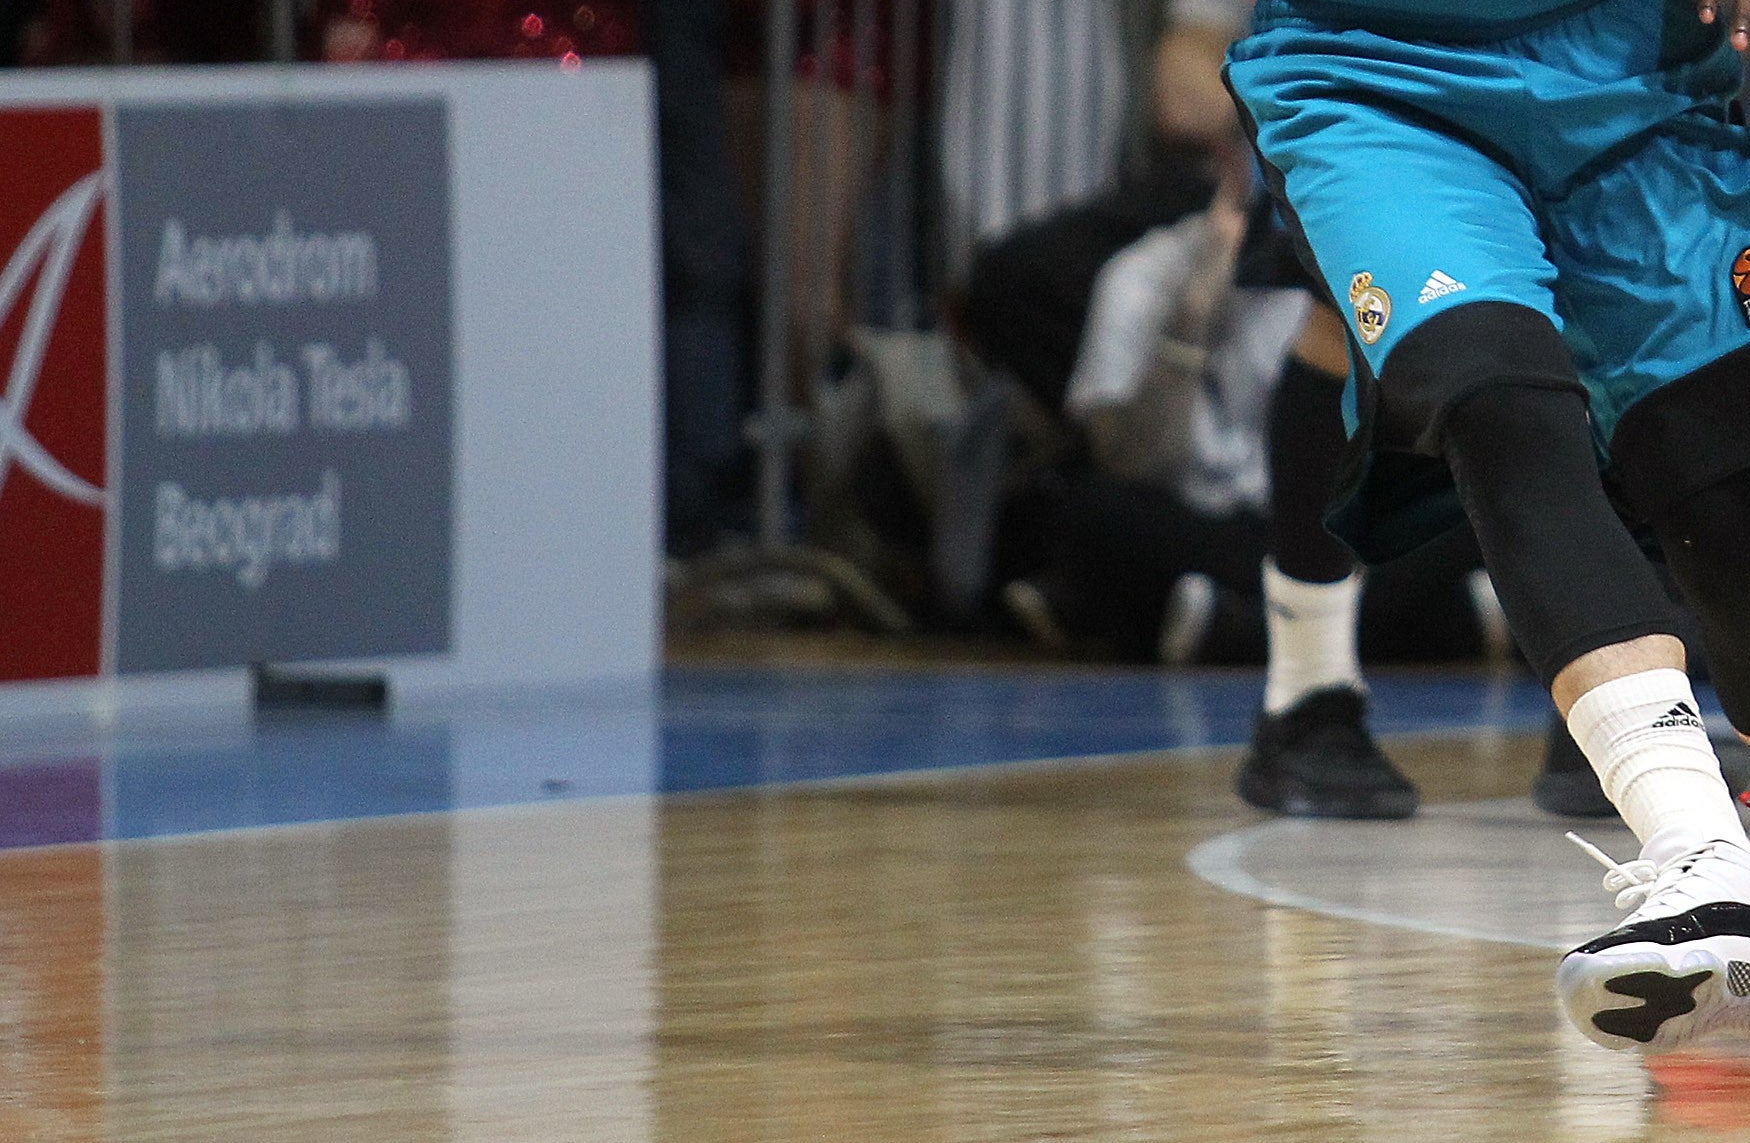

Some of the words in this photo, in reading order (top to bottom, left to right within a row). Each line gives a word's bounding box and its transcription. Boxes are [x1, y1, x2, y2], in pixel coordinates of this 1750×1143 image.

[155, 208, 379, 304] Aerodrom
[155, 338, 299, 436] Nikola
[304, 336, 411, 433] Tesla
[154, 469, 342, 589] Beograd
